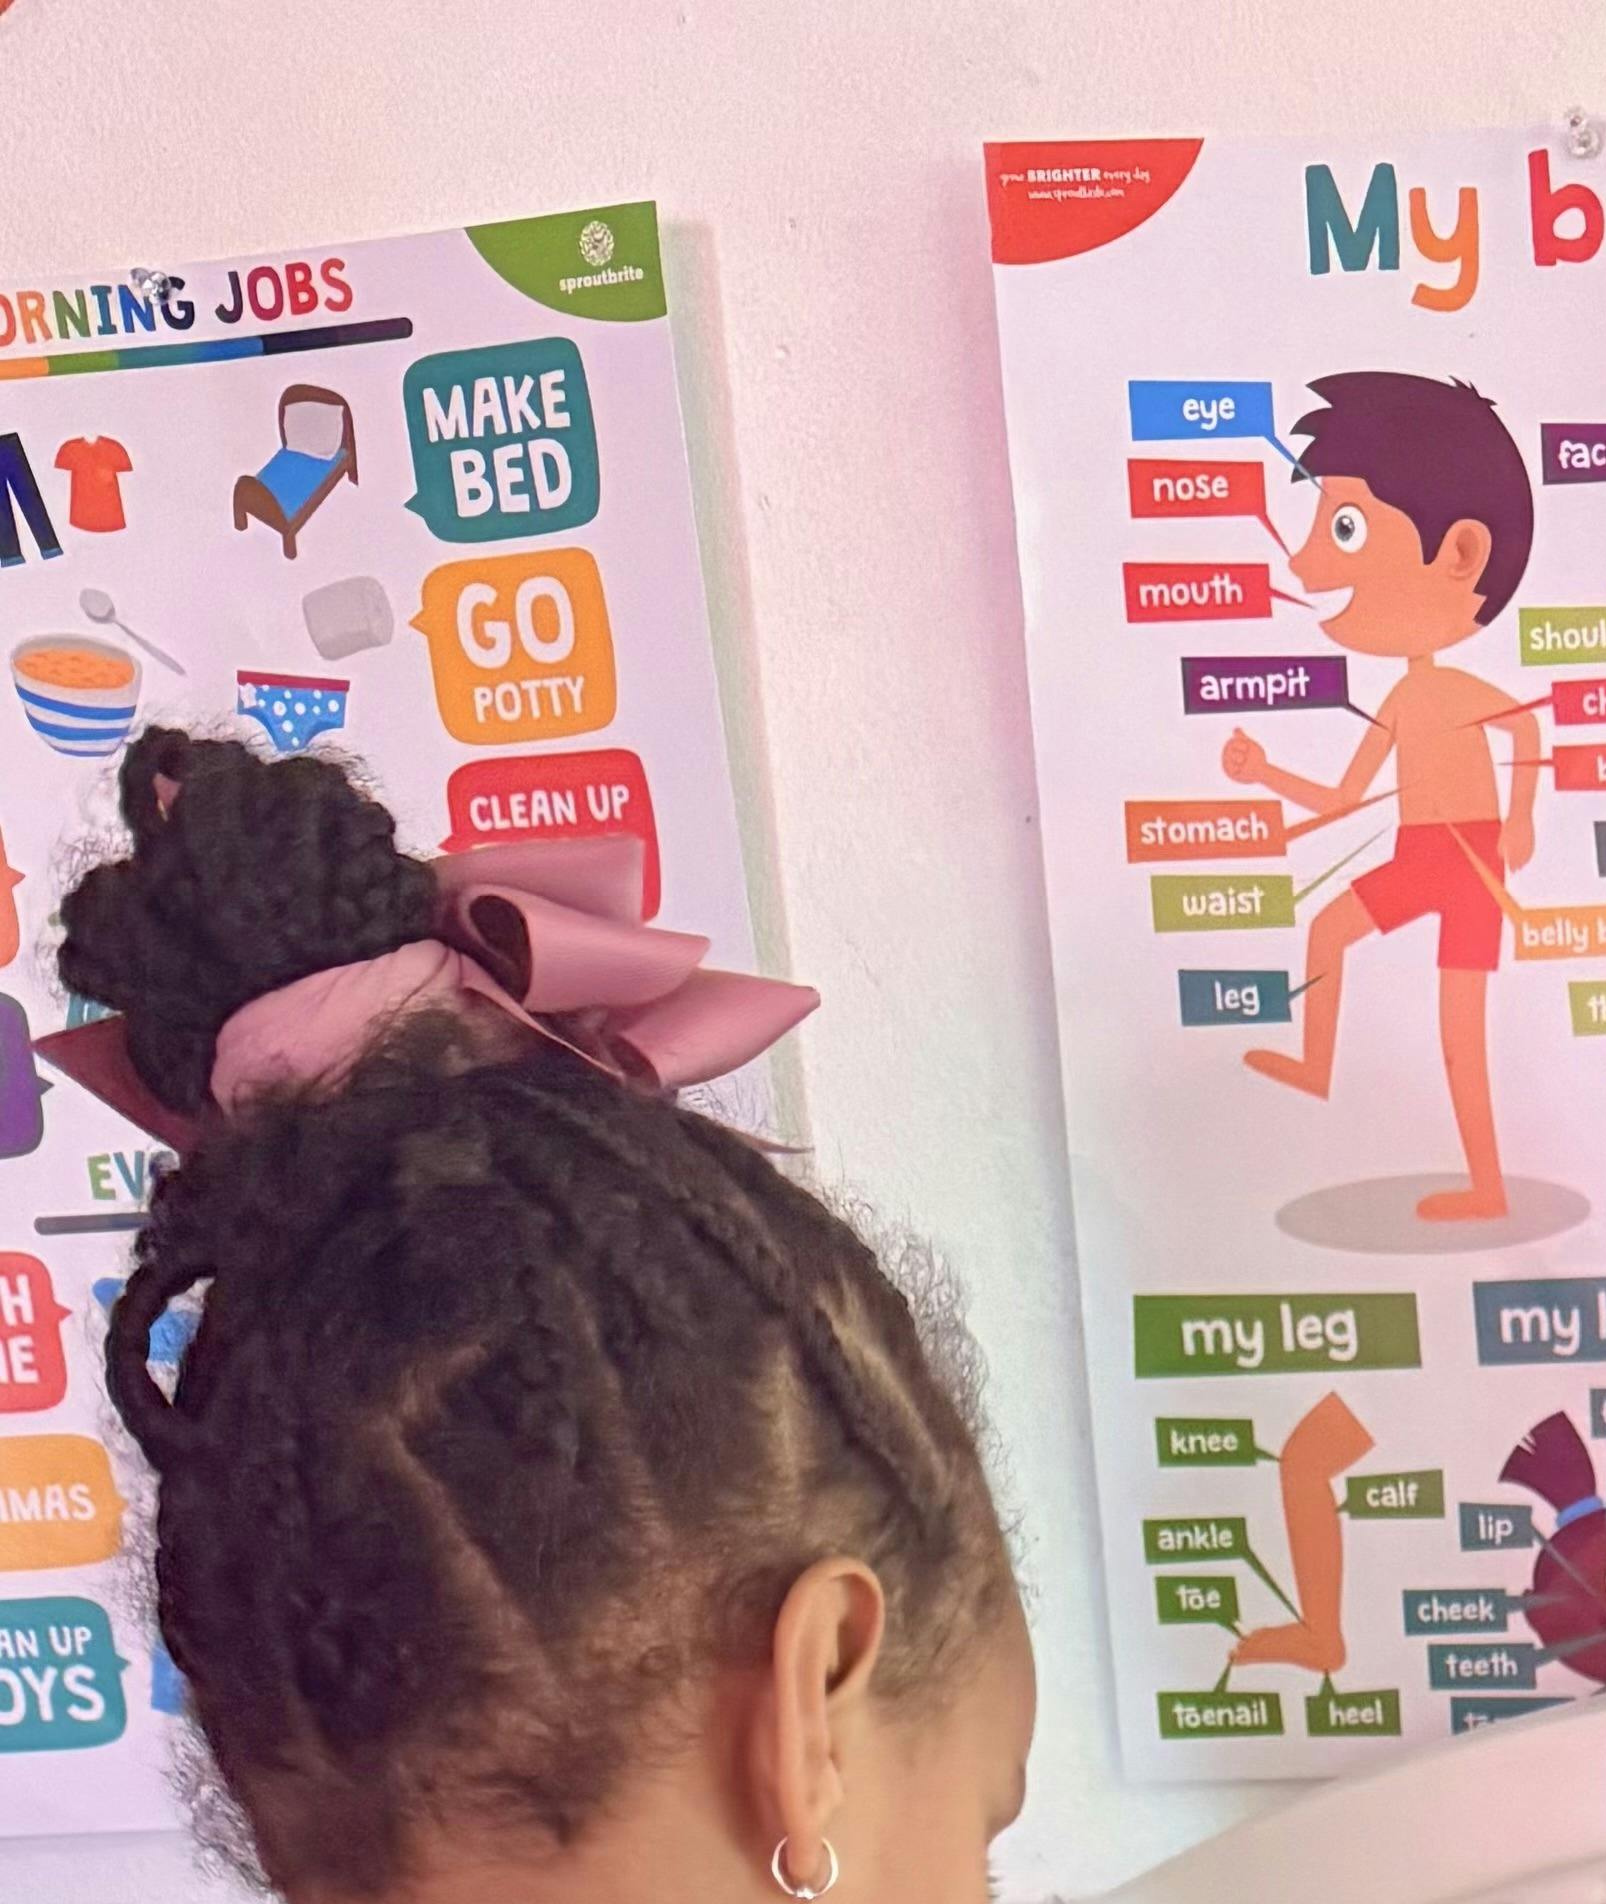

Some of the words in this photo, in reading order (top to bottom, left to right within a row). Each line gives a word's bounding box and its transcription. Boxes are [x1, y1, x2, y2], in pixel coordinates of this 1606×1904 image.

[1027, 168, 1100, 182] BRIGHTER
[1305, 162, 1480, 312] My
[215, 258, 353, 324] JOBS
[559, 264, 644, 294] sproutbrite
[423, 368, 571, 444] MAKE
[1183, 395, 1235, 430] eye
[450, 439, 573, 519] BED
[1153, 474, 1229, 501] nose
[1139, 574, 1243, 608] mouth
[456, 576, 574, 669] GO
[473, 676, 585, 724] POTTY
[1200, 667, 1310, 703] armpit
[469, 790, 577, 830] CLEAN
[587, 783, 630, 822] UP
[1141, 813, 1269, 843] stomach
[1183, 886, 1264, 916] waist
[1523, 919, 1589, 953] belly
[1215, 981, 1260, 1016] leg
[1182, 1317, 1264, 1367] my
[1281, 1302, 1358, 1361] leg
[1500, 1306, 1581, 1356] my
[1170, 1430, 1239, 1455] knee
[1366, 1482, 1418, 1507] calf
[1158, 1521, 1234, 1549] ankle
[1478, 1514, 1513, 1542] lip
[1177, 1587, 1221, 1611] toe
[1417, 1597, 1496, 1622] cheek
[49, 1626, 92, 1657] UP
[1446, 1652, 1518, 1678] teeth
[1174, 1703, 1268, 1729] toenail
[1329, 1700, 1383, 1725] heel
